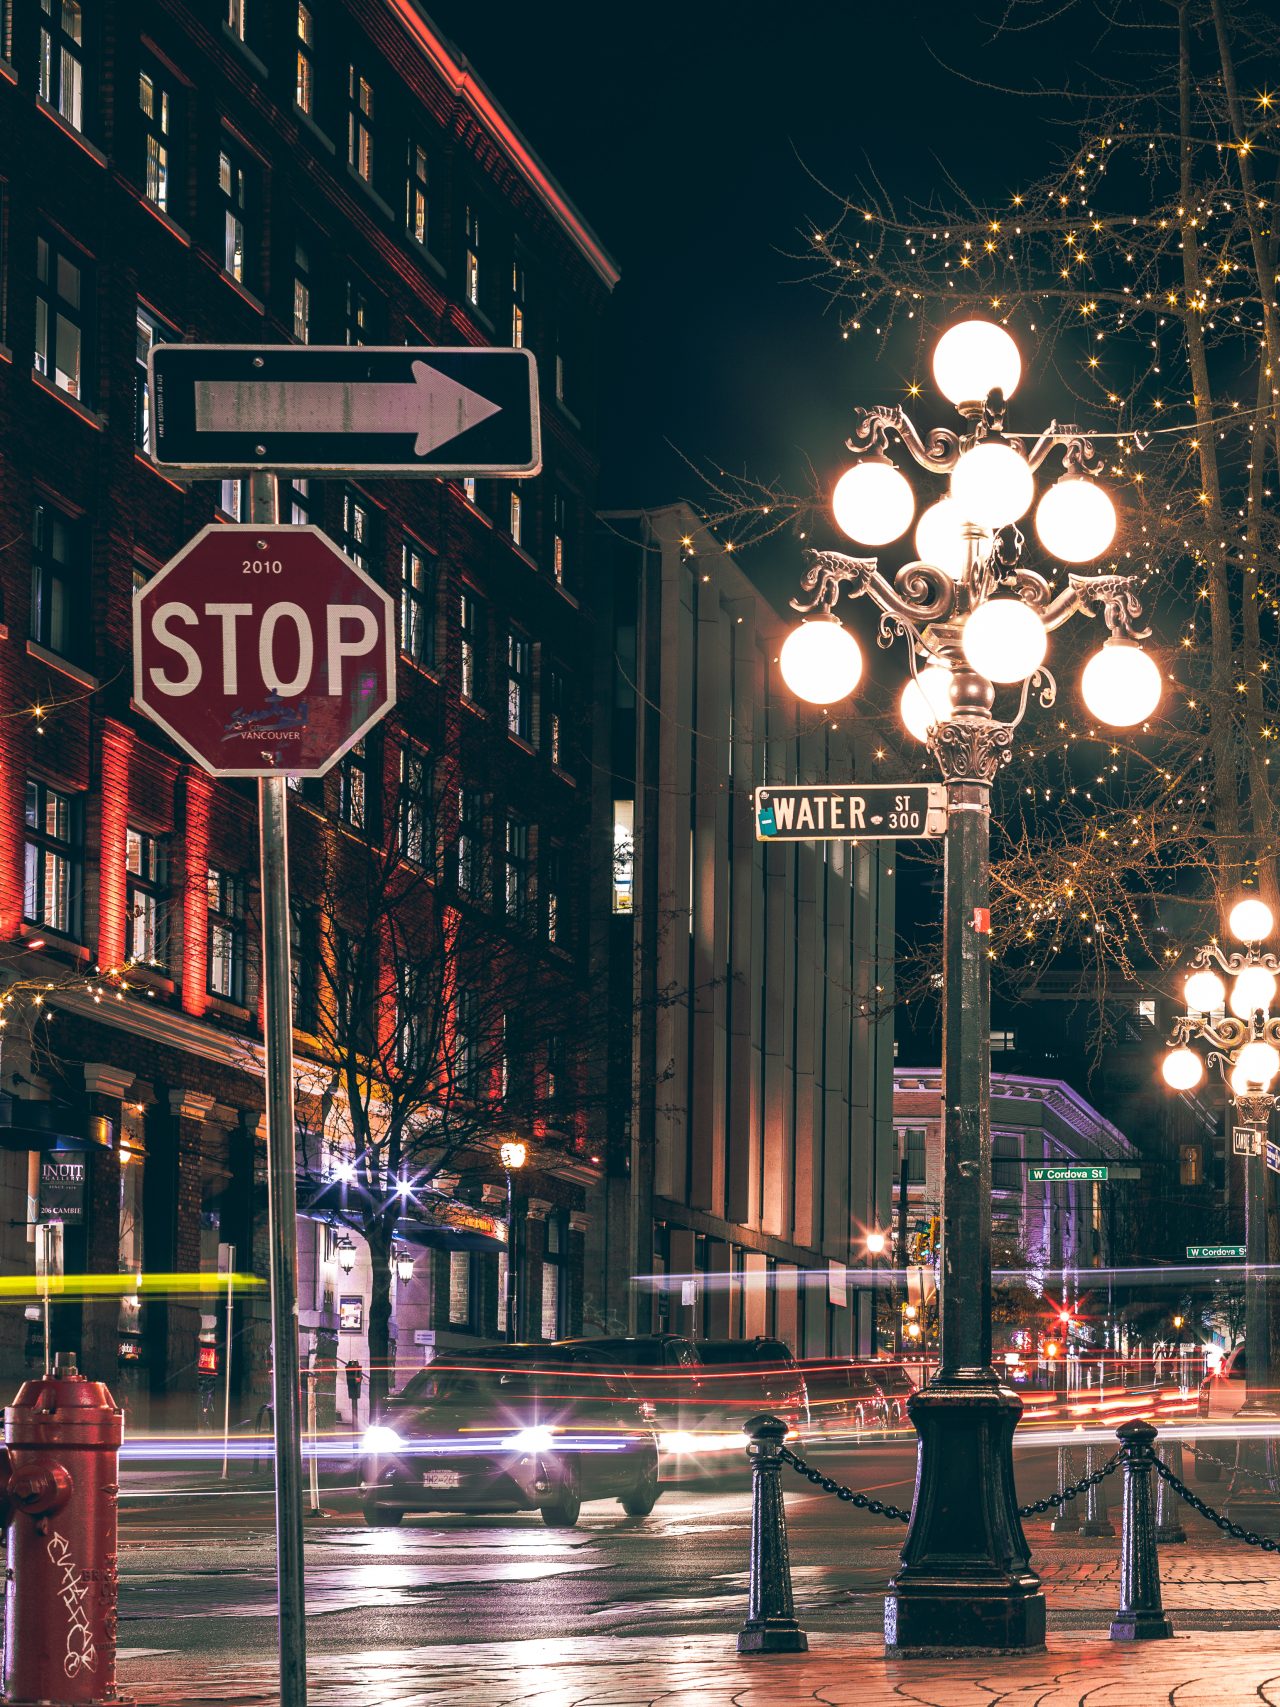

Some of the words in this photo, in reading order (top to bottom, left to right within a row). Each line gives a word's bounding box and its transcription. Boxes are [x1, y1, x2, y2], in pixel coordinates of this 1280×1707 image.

[242, 560, 282, 574] 2010
[150, 601, 379, 697] STOP
[241, 731, 300, 740] VANCOUVER
[773, 797, 866, 830] WATER
[895, 795, 911, 811] ST
[888, 813, 919, 829] 300
[43, 1164, 83, 1177] INUIT
[1033, 1170, 1044, 1179] W
[1047, 1169, 1088, 1179] Cordova
[1091, 1169, 1103, 1178] St
[1191, 1248, 1199, 1256] W
[1202, 1248, 1236, 1256] Cordova
